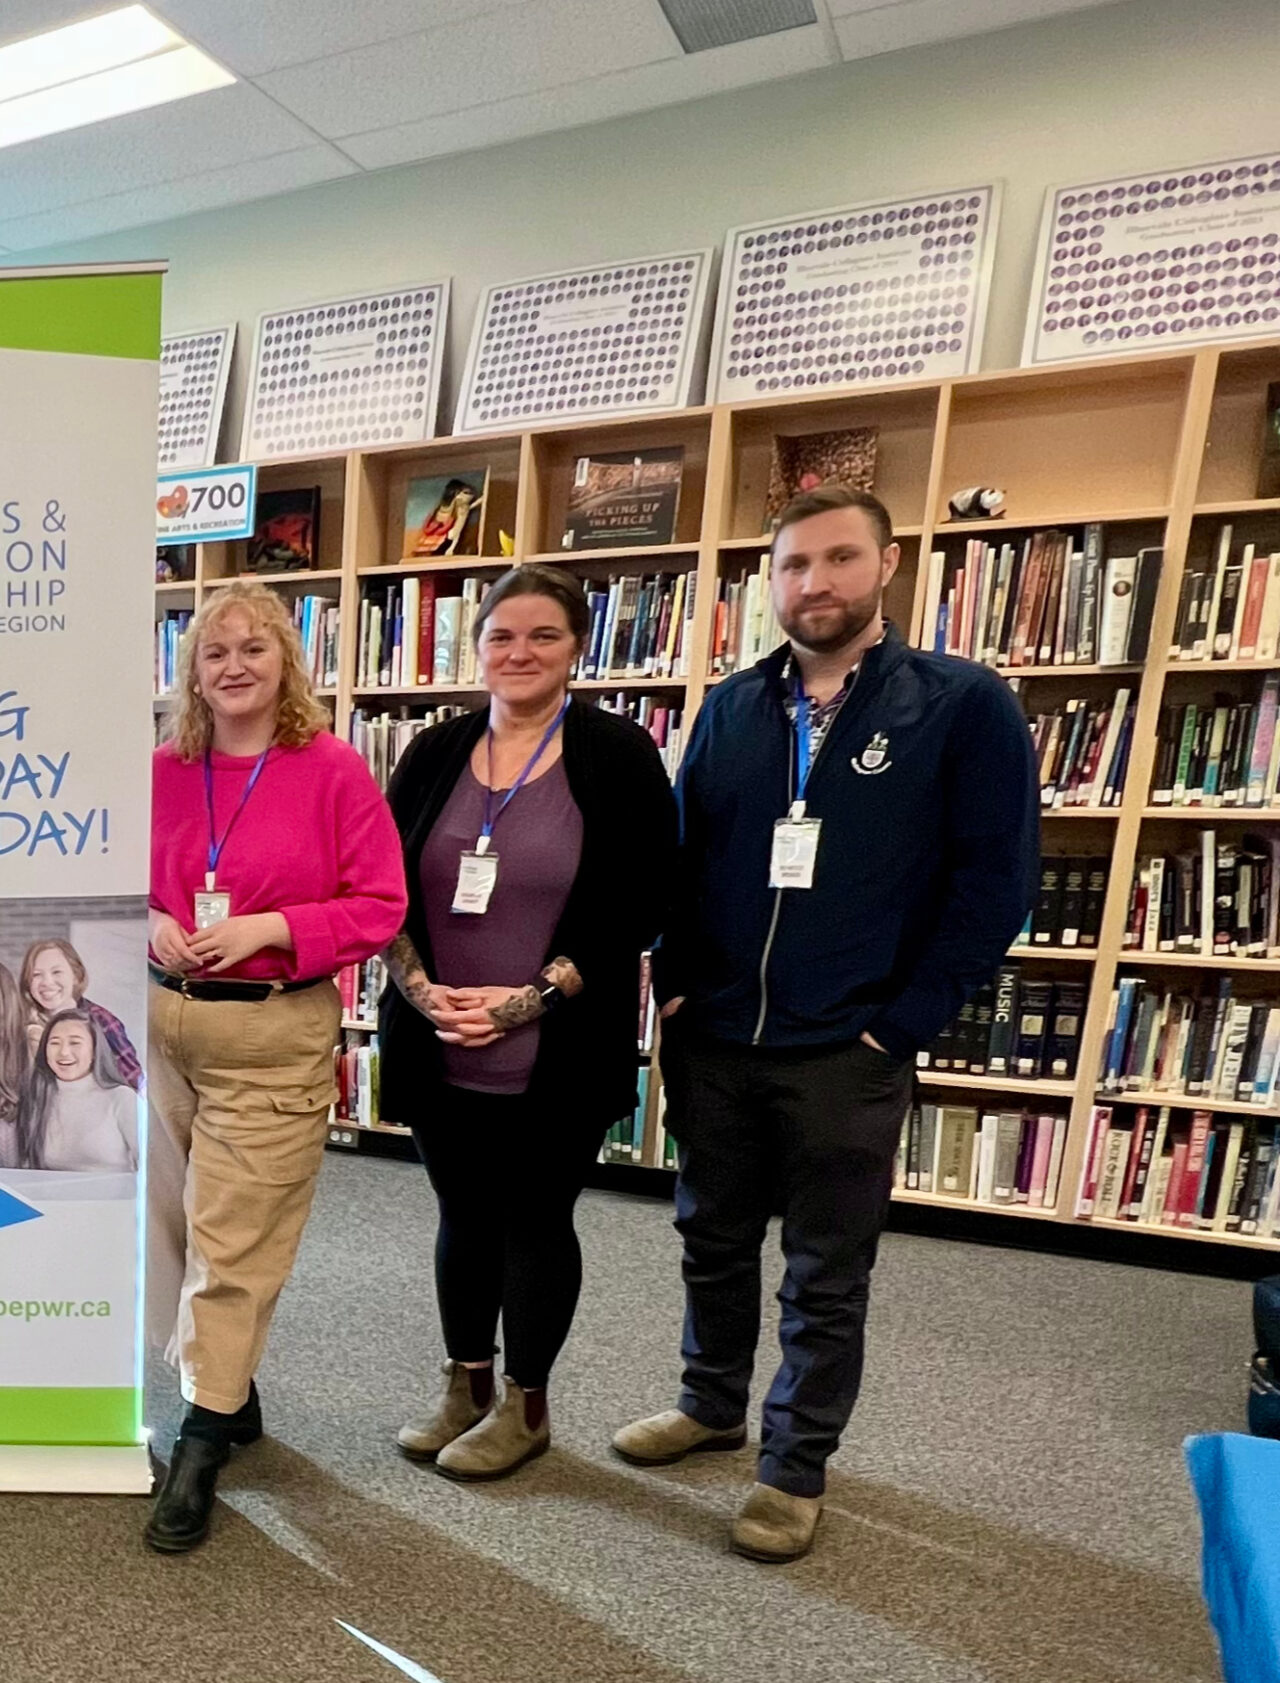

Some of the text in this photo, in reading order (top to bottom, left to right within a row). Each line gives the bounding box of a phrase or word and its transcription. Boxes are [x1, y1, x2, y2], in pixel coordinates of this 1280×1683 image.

[191, 482, 245, 513] 700
[585, 503, 660, 517] PICKING UP
[43, 500, 66, 533] &
[610, 514, 653, 526] PIECES
[995, 973, 1015, 1023] MUSIC
